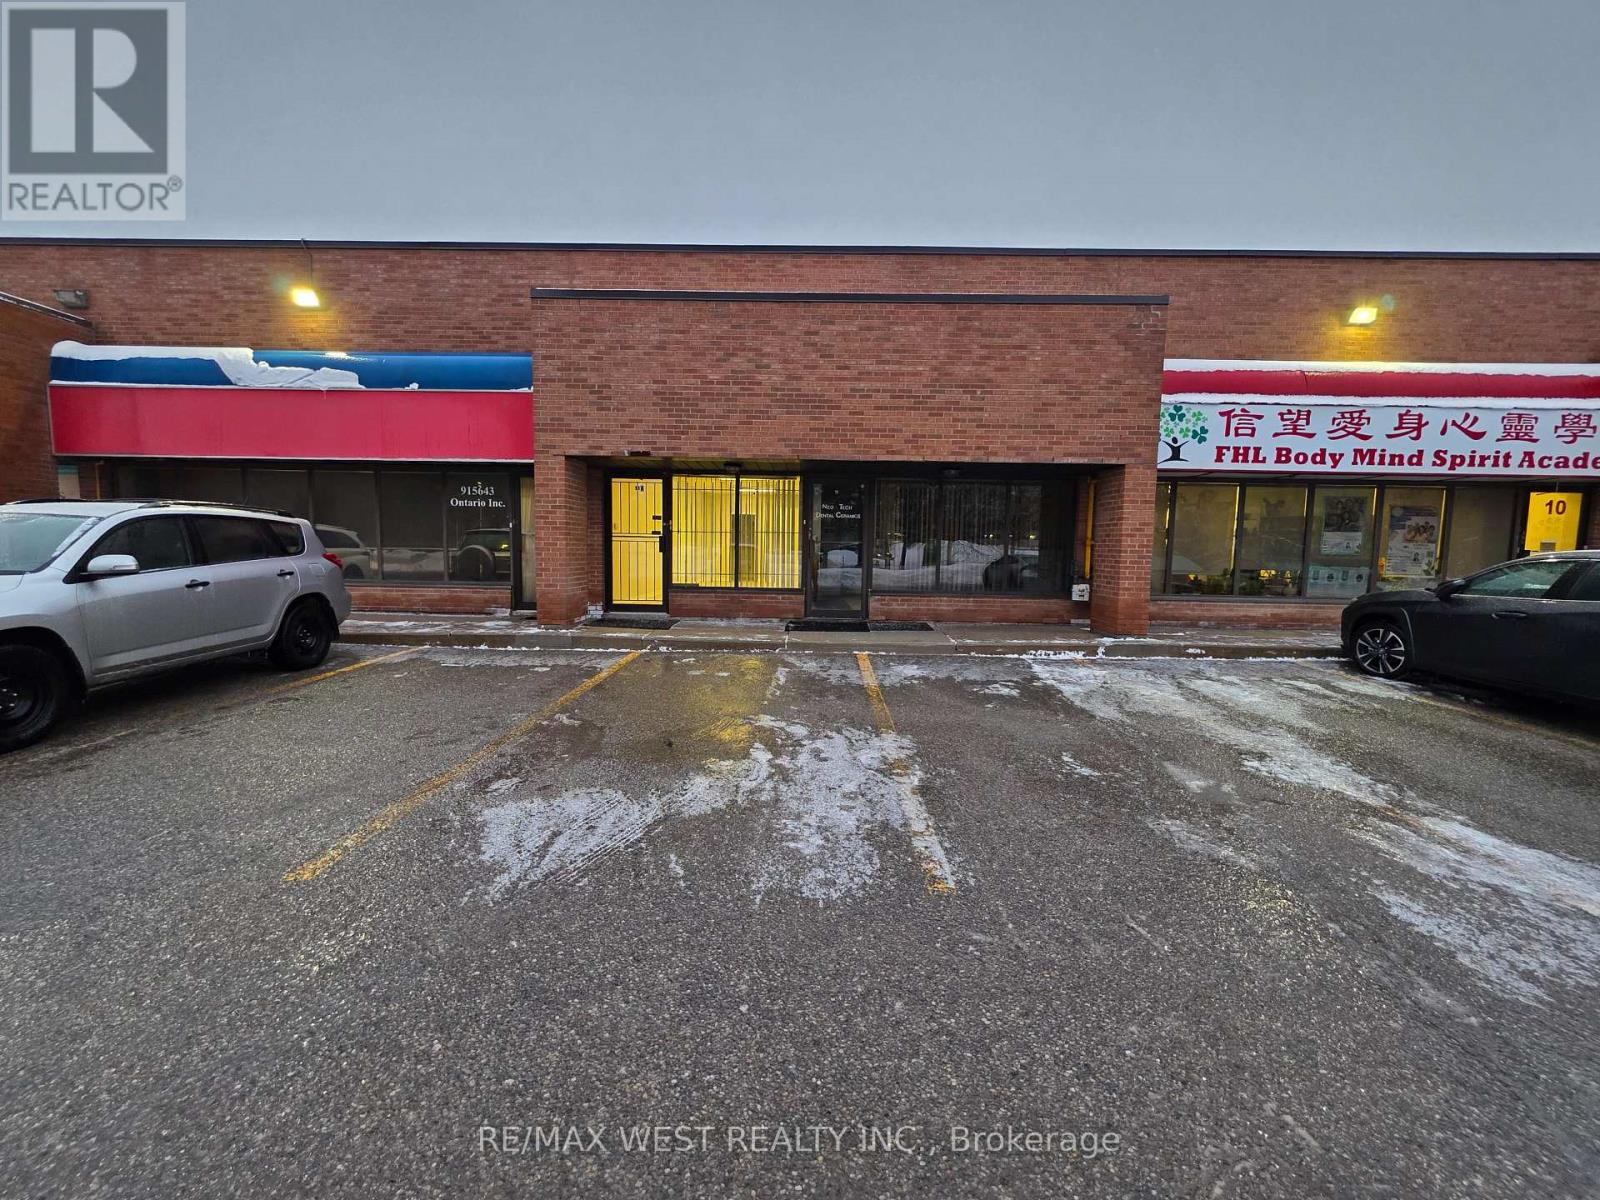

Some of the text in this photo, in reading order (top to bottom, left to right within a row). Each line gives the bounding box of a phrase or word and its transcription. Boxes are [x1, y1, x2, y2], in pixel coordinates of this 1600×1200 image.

[1218, 408, 1598, 445] 信望愛身心靈學
[1214, 445, 1600, 472] FHL Body Mind Spirit Acade
[450, 497, 506, 508] Ontario Inc.
[1545, 499, 1567, 515] 10
